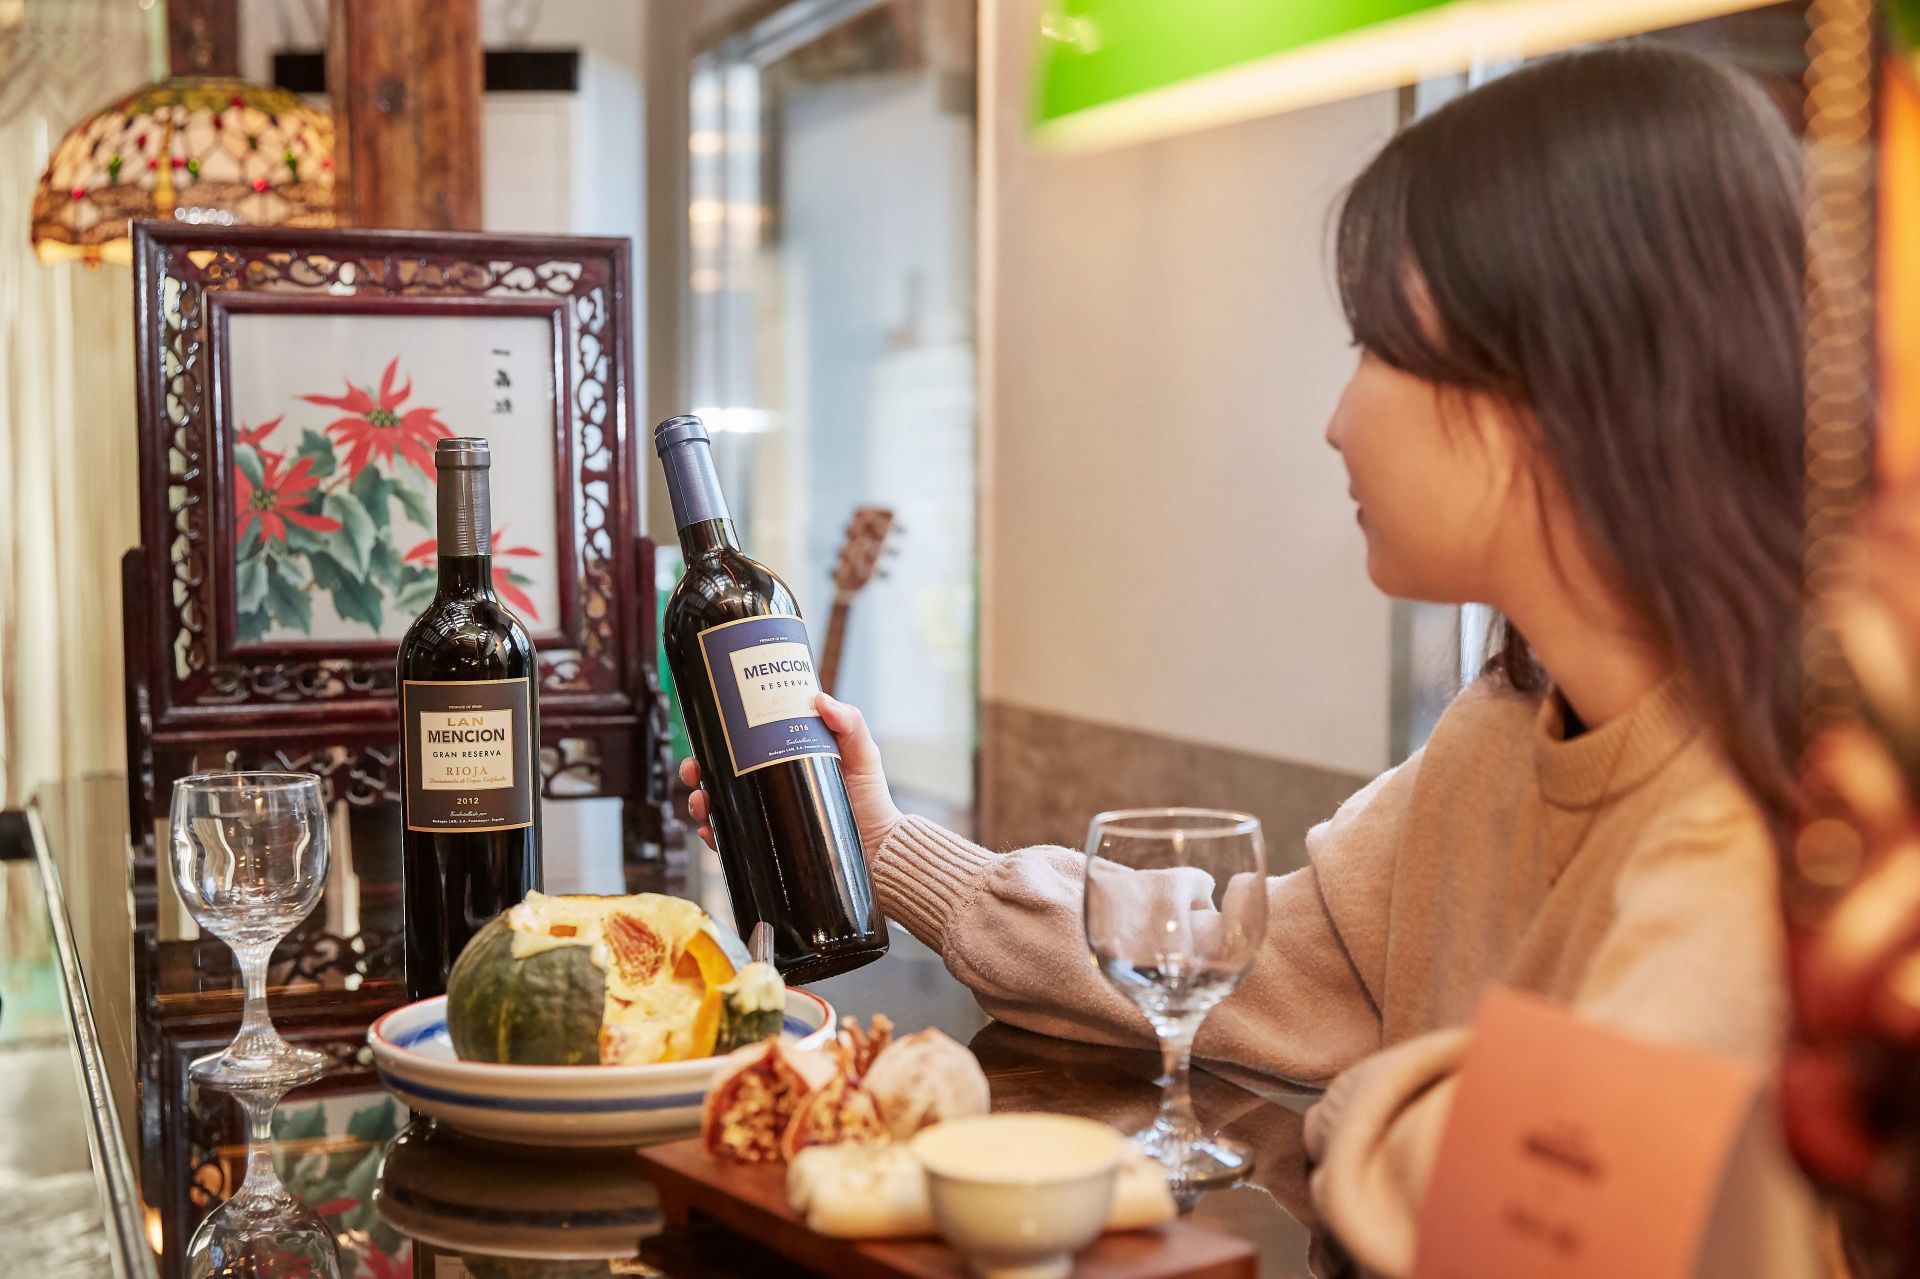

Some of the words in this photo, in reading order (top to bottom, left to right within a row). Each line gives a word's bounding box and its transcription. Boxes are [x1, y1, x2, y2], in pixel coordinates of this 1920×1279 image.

[744, 660, 811, 680] MENCION
[761, 680, 809, 691] RESERVA
[447, 717, 484, 726] LAN
[789, 724, 809, 733] 2016
[428, 729, 505, 743] MENCION
[462, 750, 501, 758] RESERVA
[446, 766, 488, 777] RIOJA
[457, 797, 479, 805] 2012
